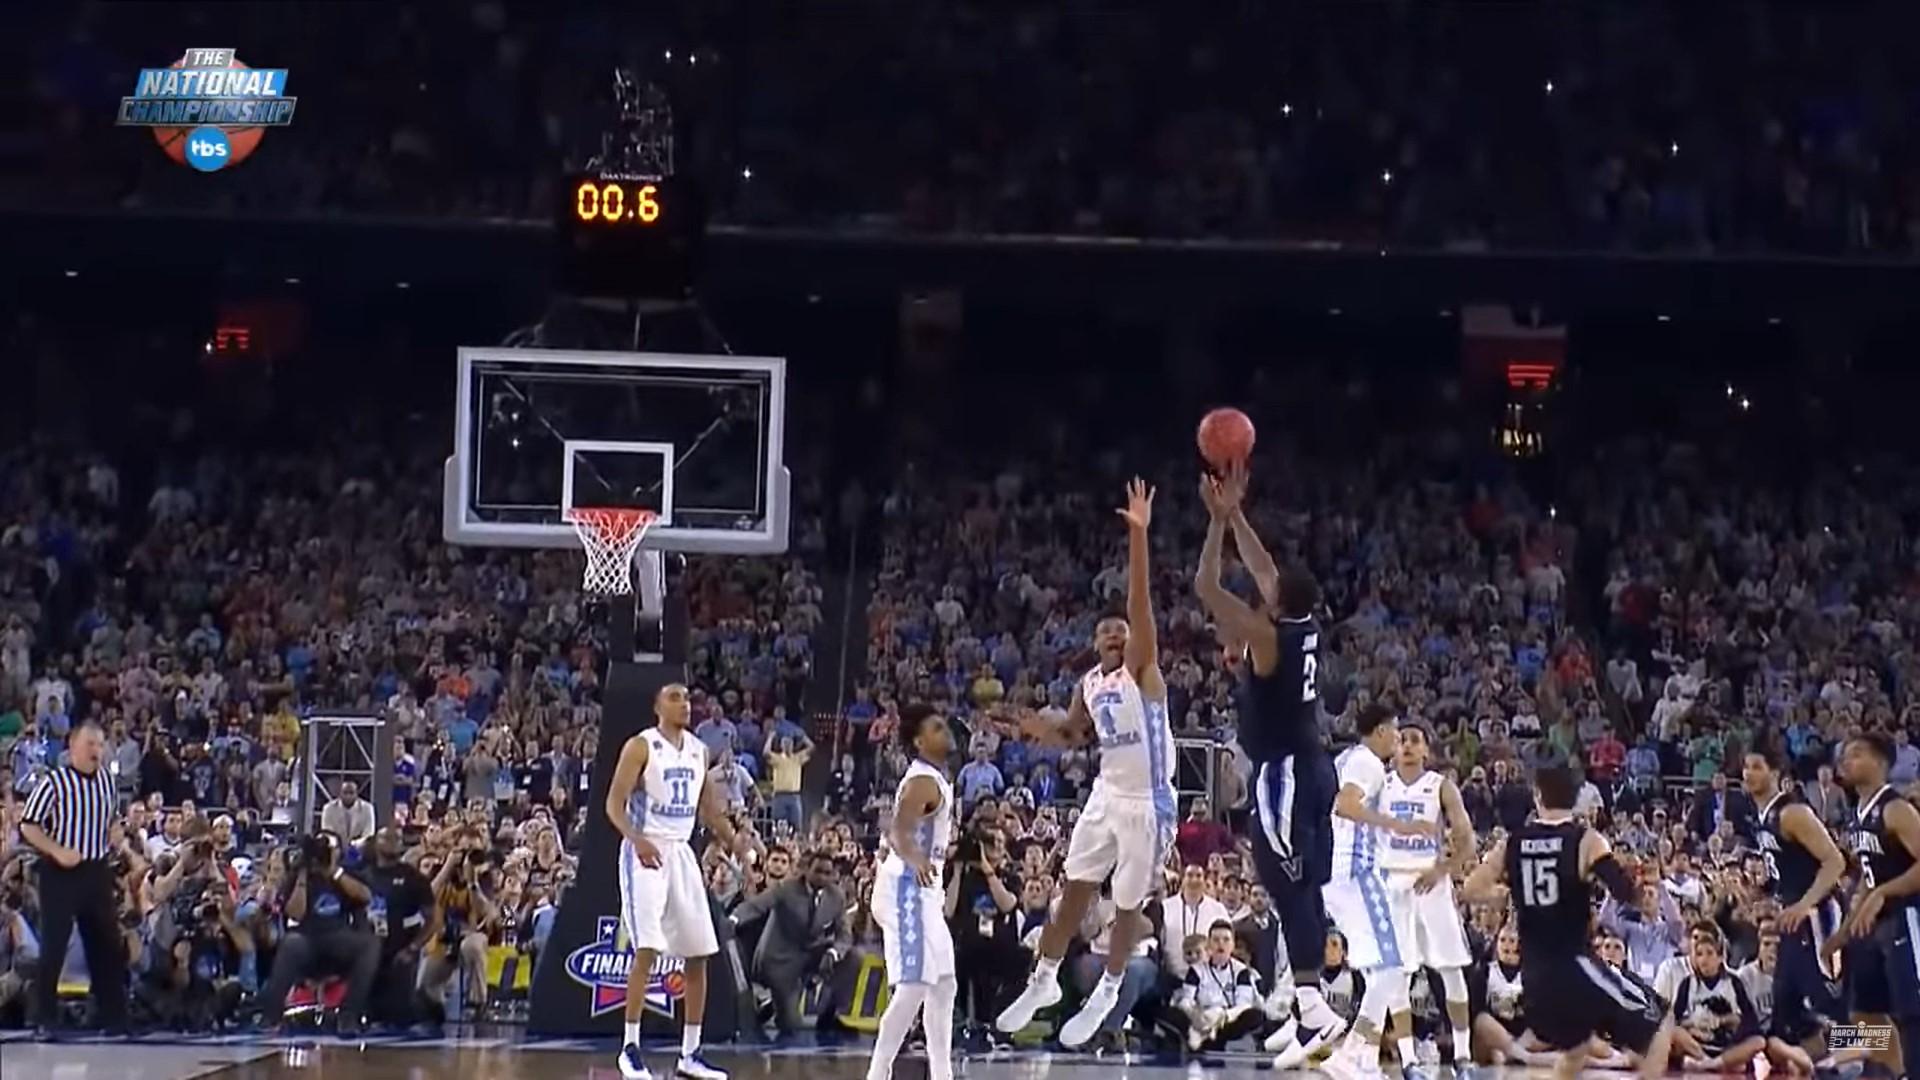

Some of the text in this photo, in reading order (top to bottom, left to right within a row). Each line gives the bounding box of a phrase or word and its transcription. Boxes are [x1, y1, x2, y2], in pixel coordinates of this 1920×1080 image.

[578, 183, 659, 222] 00.6
[1303, 653, 1317, 702] 2
[671, 781, 689, 805] 11
[1521, 858, 1559, 907] 15
[1861, 855, 1875, 889] 5
[581, 953, 633, 975] FINAL
